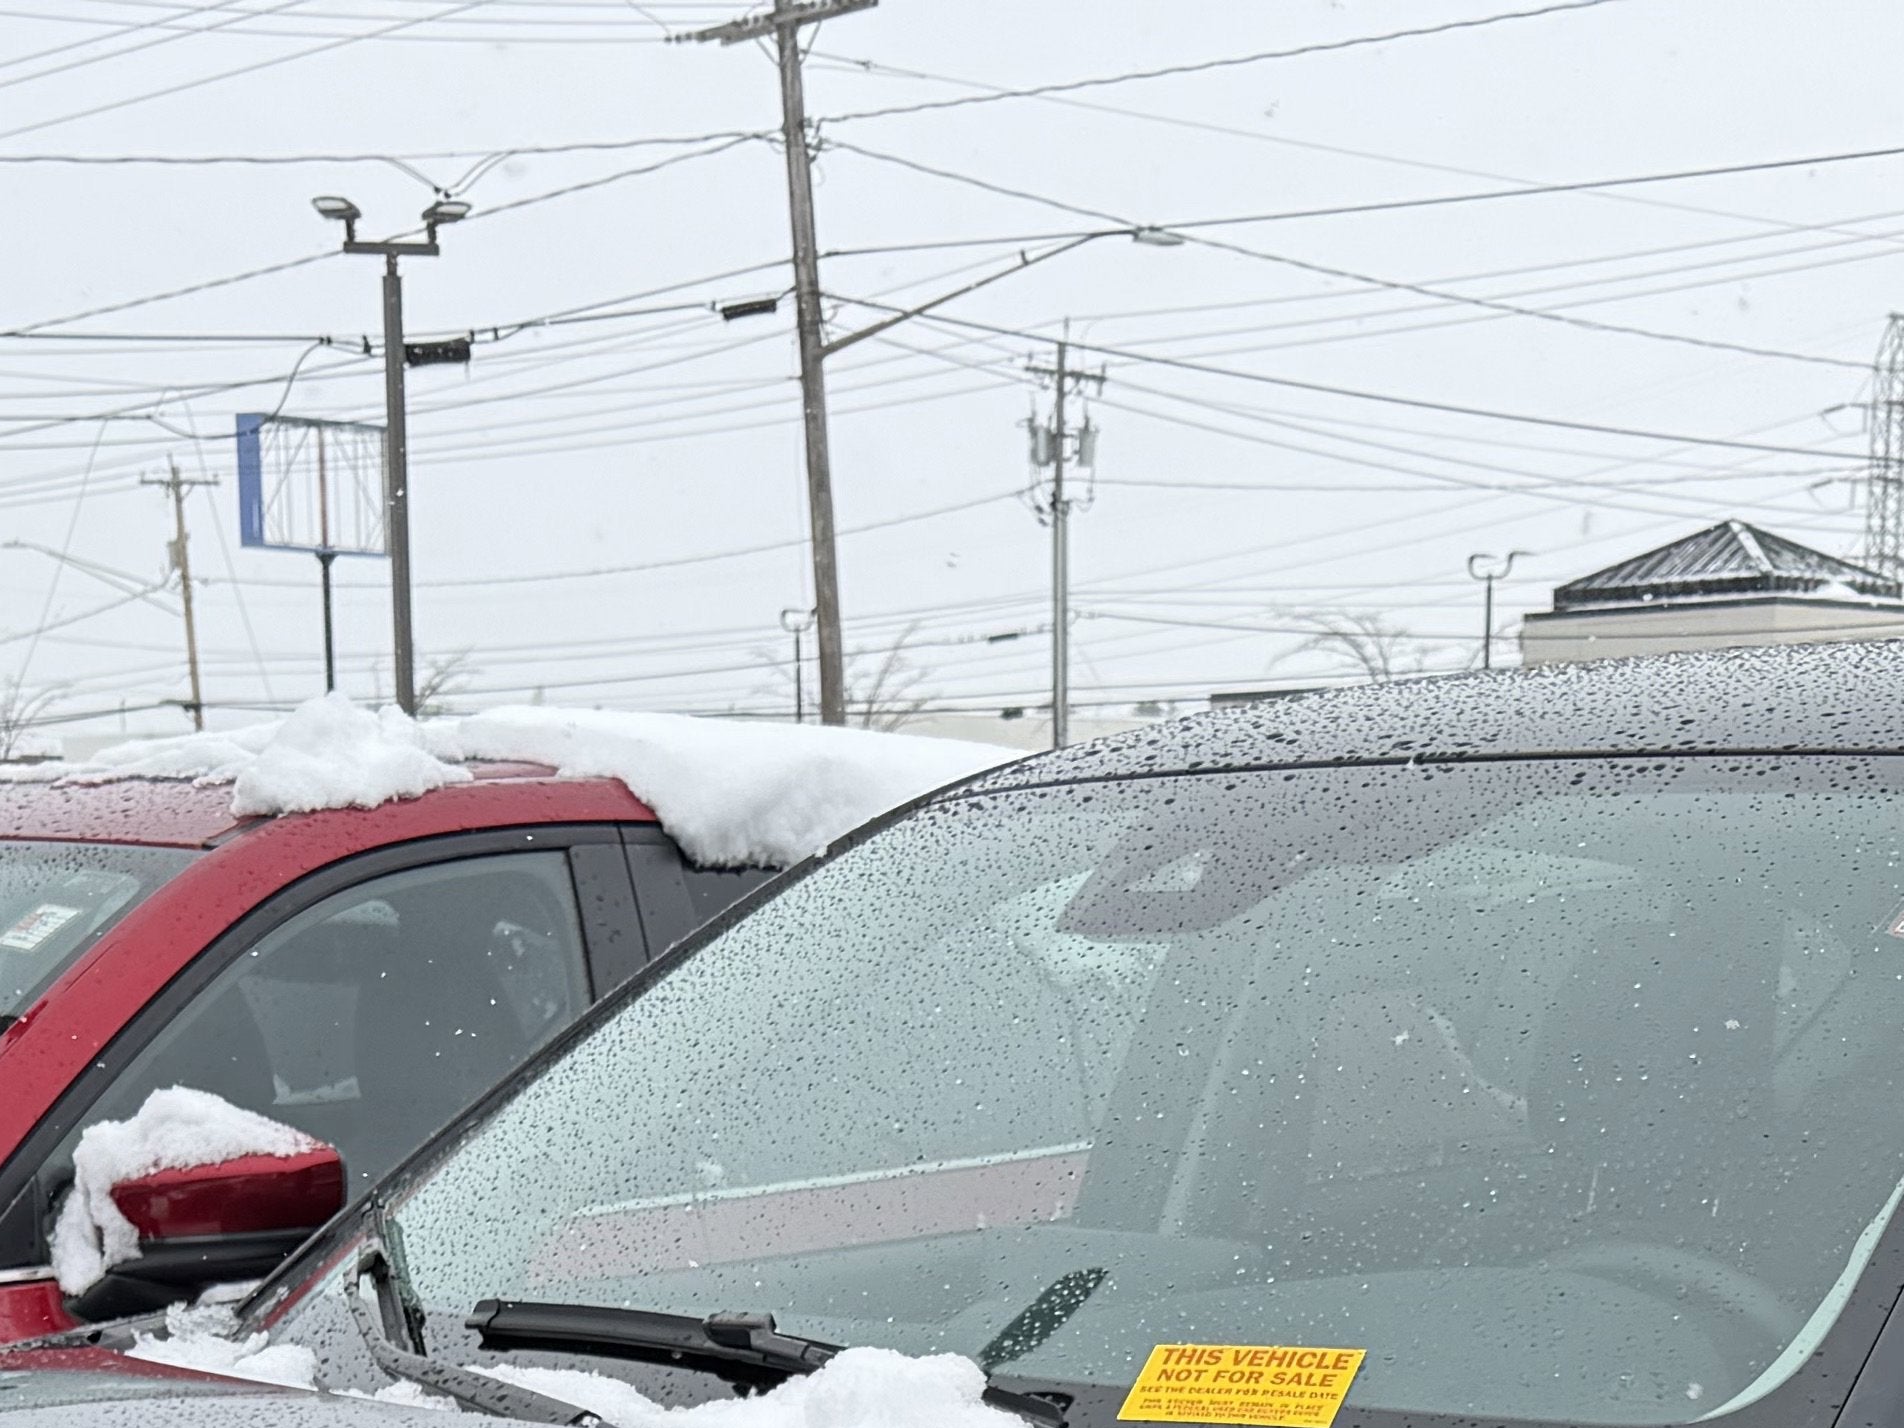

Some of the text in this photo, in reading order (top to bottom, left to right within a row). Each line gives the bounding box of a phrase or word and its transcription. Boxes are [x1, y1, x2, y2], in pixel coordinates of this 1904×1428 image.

[1163, 1348, 1354, 1370] THIS VEHICLE
[1157, 1368, 1337, 1387] NOT FOR SALE
[1190, 1387, 1233, 1395] DEALER
[1236, 1388, 1258, 1396] FOR
[1262, 1389, 1306, 1398] RESALE
[1310, 1391, 1338, 1400] DATE
